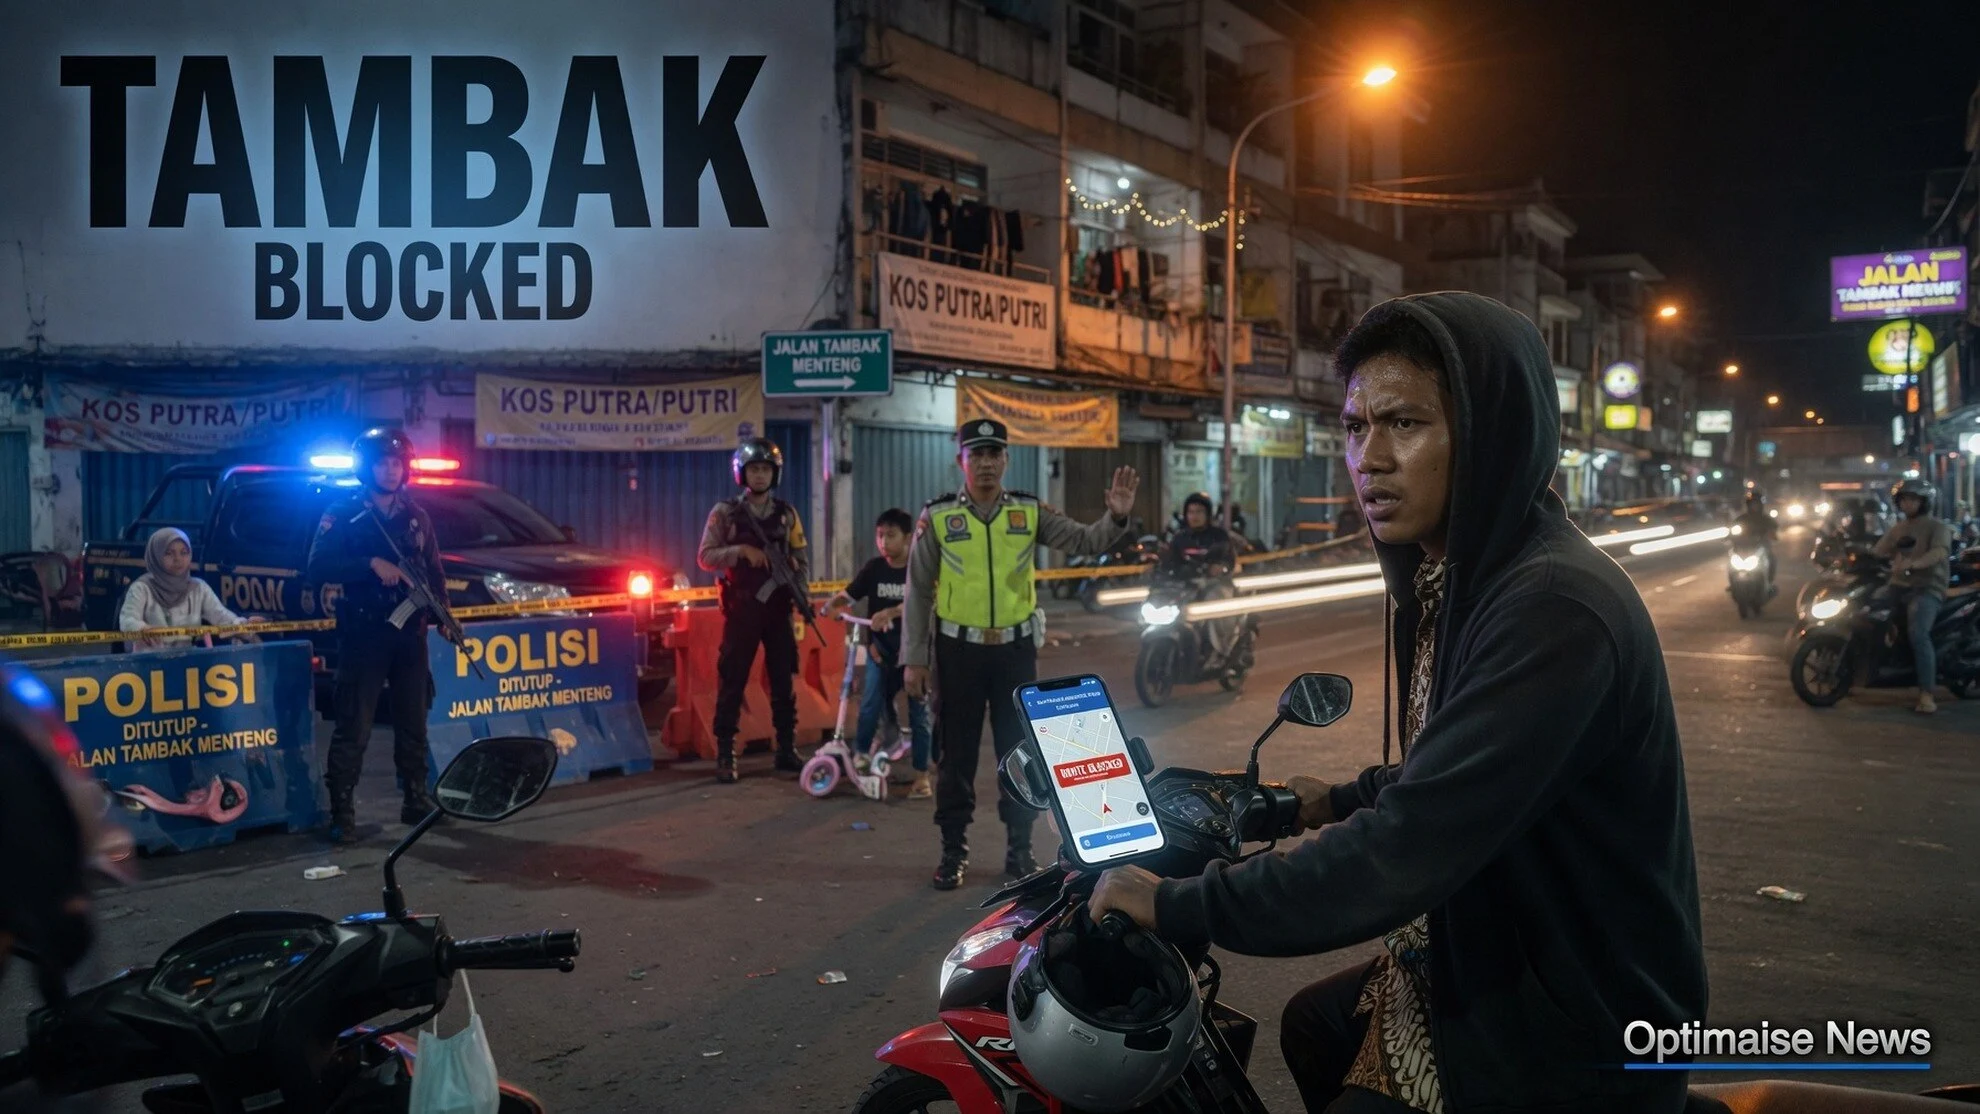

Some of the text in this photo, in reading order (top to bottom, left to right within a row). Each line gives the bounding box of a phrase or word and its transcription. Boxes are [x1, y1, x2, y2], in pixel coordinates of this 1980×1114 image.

[1858, 261, 1939, 287] JALAN
[889, 274, 928, 311] KOS
[772, 338, 819, 355] JALAN
[822, 337, 882, 353] TAMBAK
[792, 356, 862, 373] MENTENG
[82, 398, 140, 424] KOS
[501, 387, 738, 416] KOS PUTRA/PUTRI
[455, 628, 599, 677] POLISI
[63, 663, 256, 722] POLISI
[499, 673, 554, 693] DITUTUP
[448, 685, 612, 719] JALAN TAMBAK MENTENG
[123, 716, 197, 741] DITUTUP
[67, 728, 278, 769] ALAN TAMBAK MENTENG
